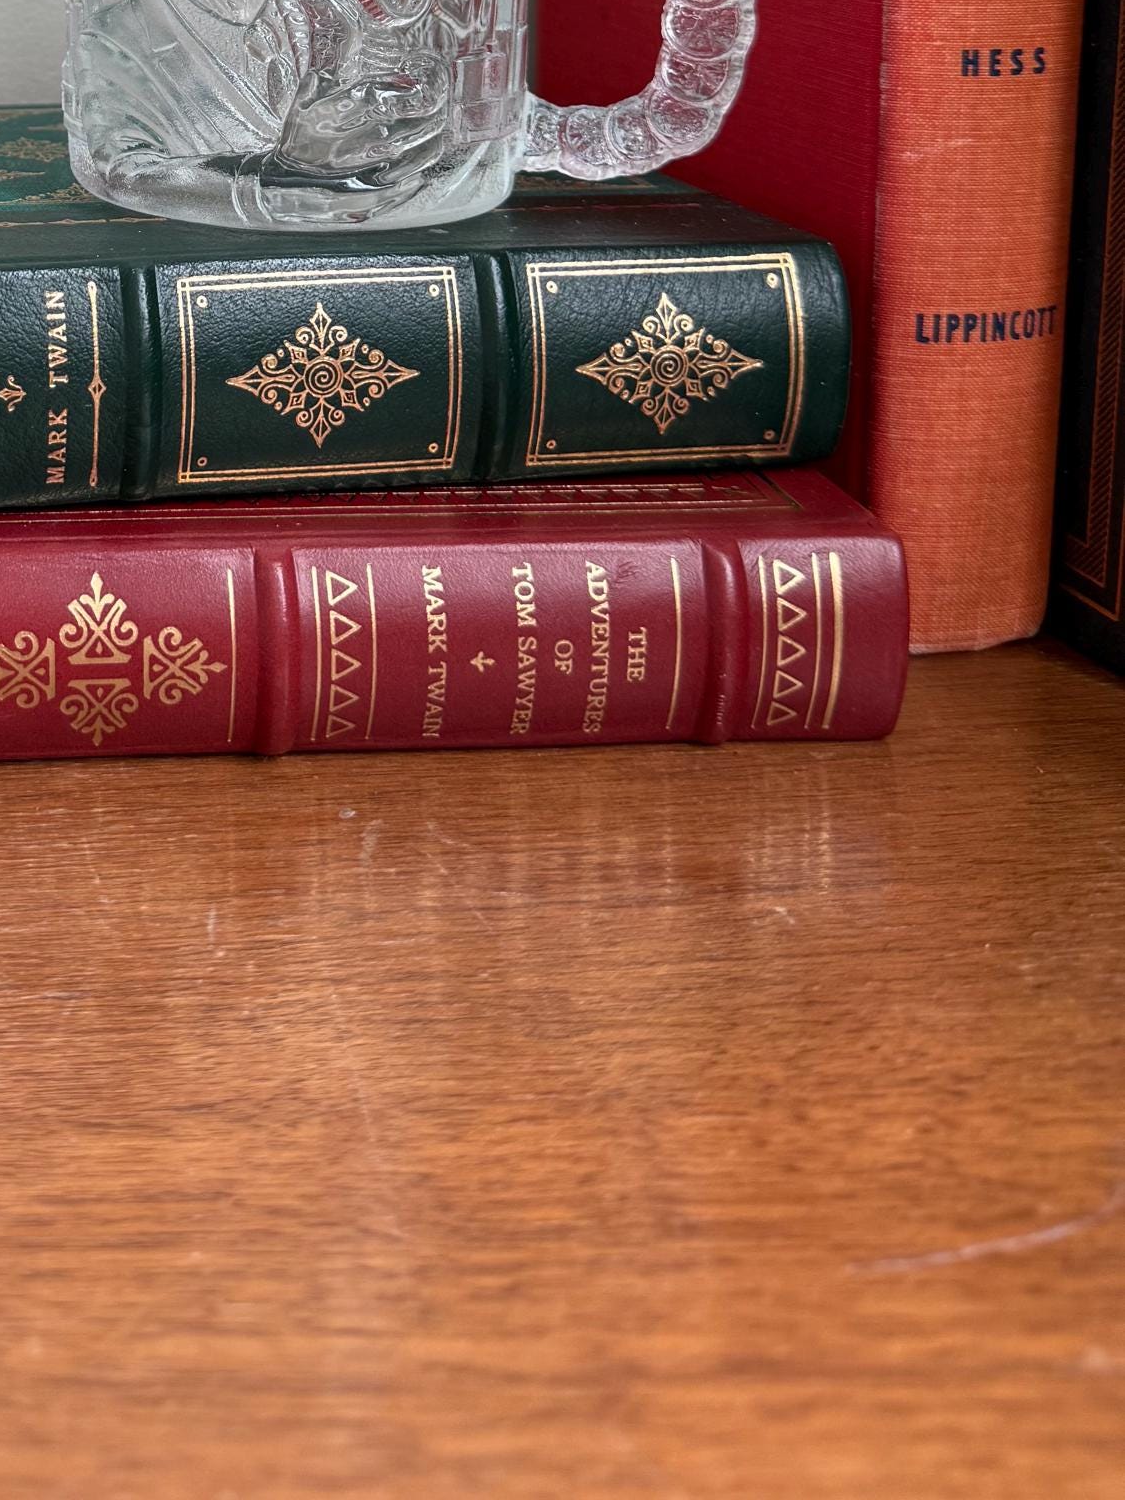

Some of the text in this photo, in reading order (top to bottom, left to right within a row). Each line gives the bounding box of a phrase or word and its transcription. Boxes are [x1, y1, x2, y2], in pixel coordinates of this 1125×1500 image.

[961, 47, 1046, 77] HESS
[915, 306, 1057, 343] LIPPINCOTT
[45, 290, 69, 484] MARK TWAIN
[420, 565, 448, 739] MARK TWAIN
[510, 562, 537, 735] TOM SAWYER
[554, 639, 573, 674] OF
[583, 561, 611, 734] ADVENTURES
[627, 627, 647, 681] THE
